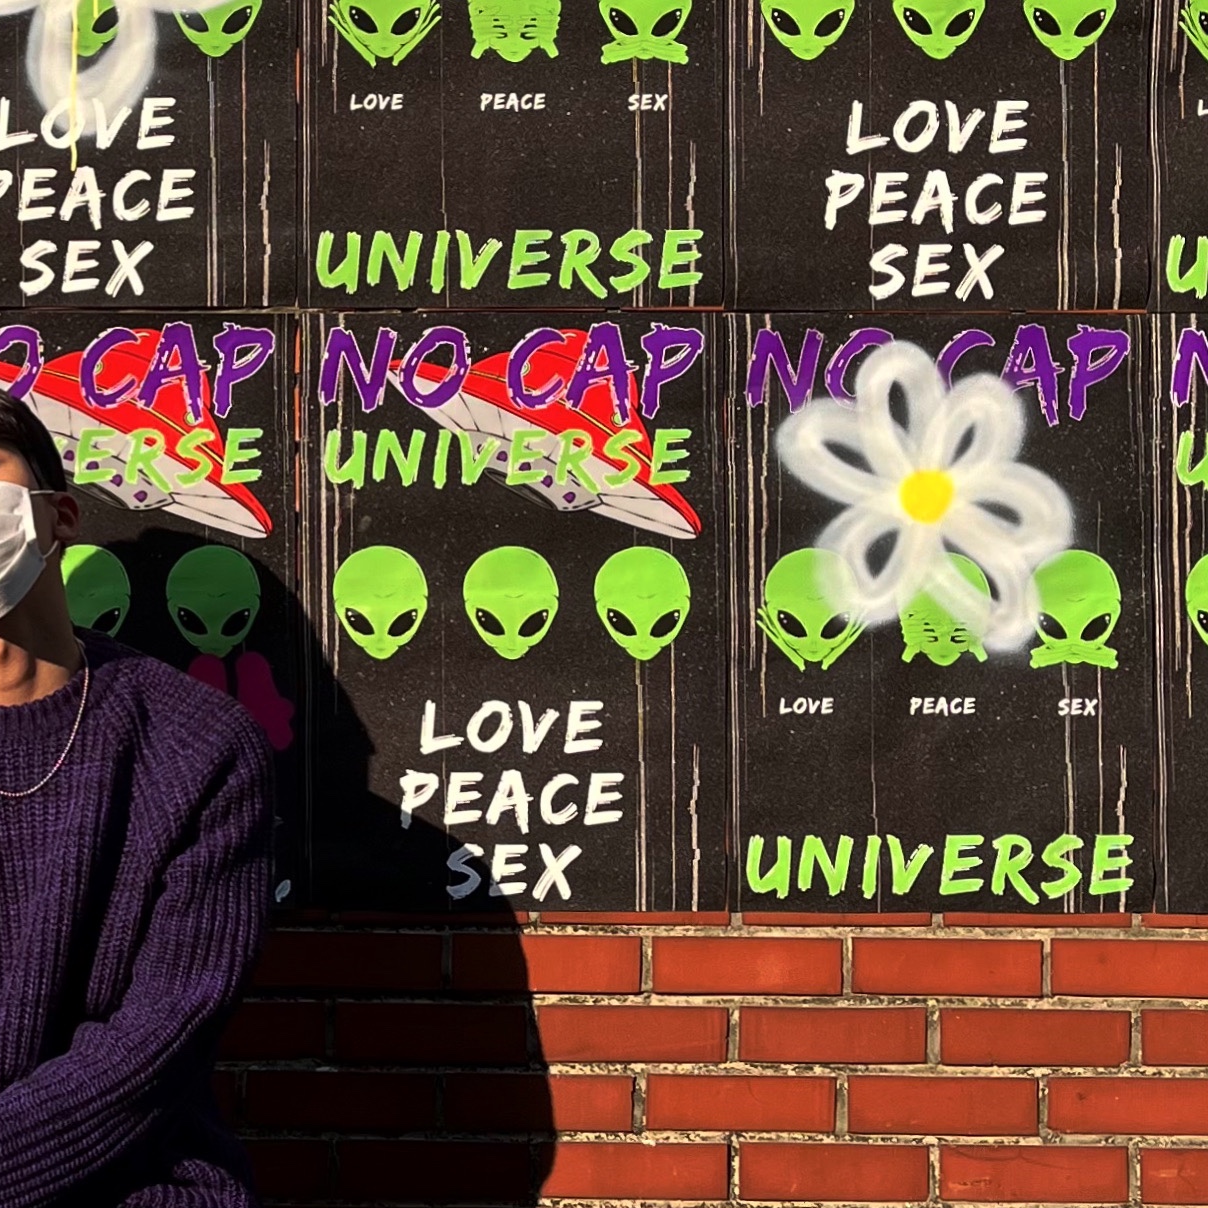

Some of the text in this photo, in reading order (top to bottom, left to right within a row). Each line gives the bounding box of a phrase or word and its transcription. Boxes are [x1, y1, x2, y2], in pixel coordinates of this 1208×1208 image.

[350, 92, 668, 112] LOVE PEACE SEX
[845, 99, 1029, 155] LOVE
[824, 169, 1049, 235] PEACE
[19, 239, 154, 298] SEX
[315, 229, 702, 299] UNIVERSE
[868, 243, 1005, 302] SEX
[79, 322, 275, 423] CAP
[318, 322, 704, 424] NO CAP
[54, 428, 263, 494] ERSE
[323, 428, 690, 495] UNIVERSE
[419, 699, 604, 755] LOVE
[779, 696, 1098, 717] LOVE PEACE SEX
[399, 768, 625, 835] PEACE
[446, 843, 583, 902] SEX
[745, 833, 1132, 905] UNIVERSE
